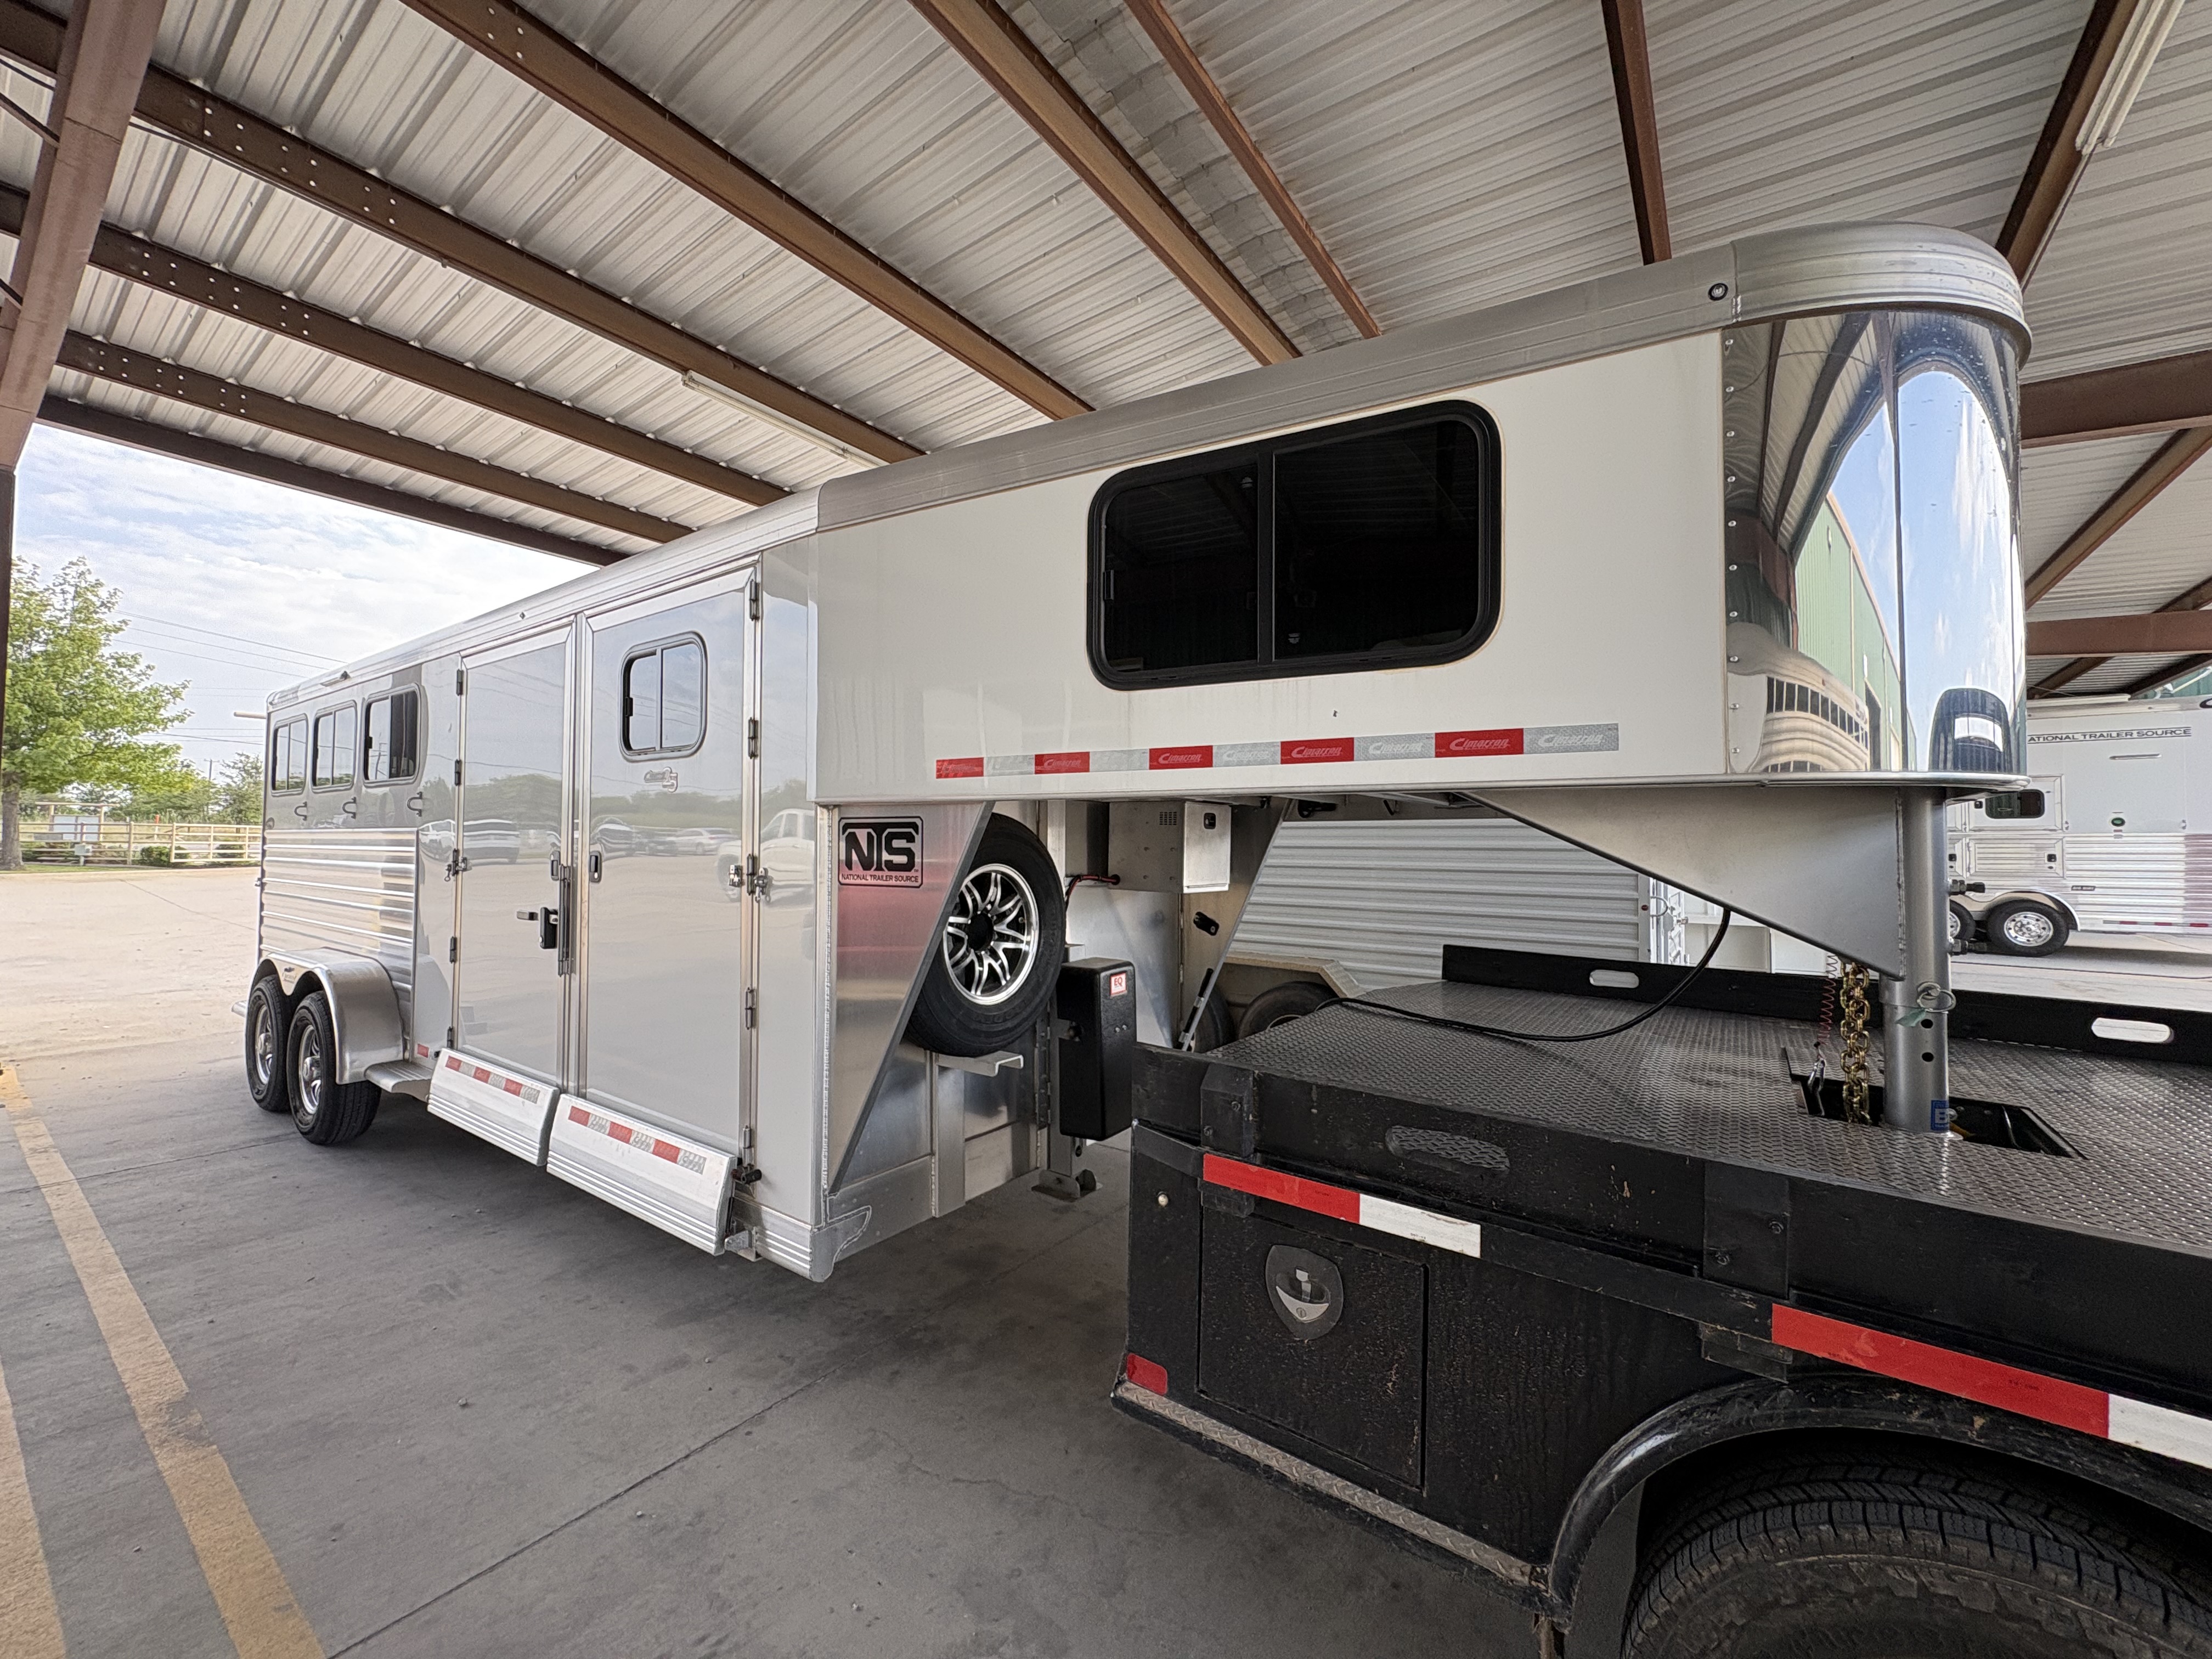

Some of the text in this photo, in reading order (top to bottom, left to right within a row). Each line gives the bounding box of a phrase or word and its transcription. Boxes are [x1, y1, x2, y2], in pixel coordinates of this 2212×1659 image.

[2136, 729, 2192, 737] SOURCE
[1158, 753, 1203, 764] Cimarron
[1291, 746, 1342, 758] Cimarron
[1449, 737, 1510, 750] Cimarron
[842, 822, 919, 872] NTS
